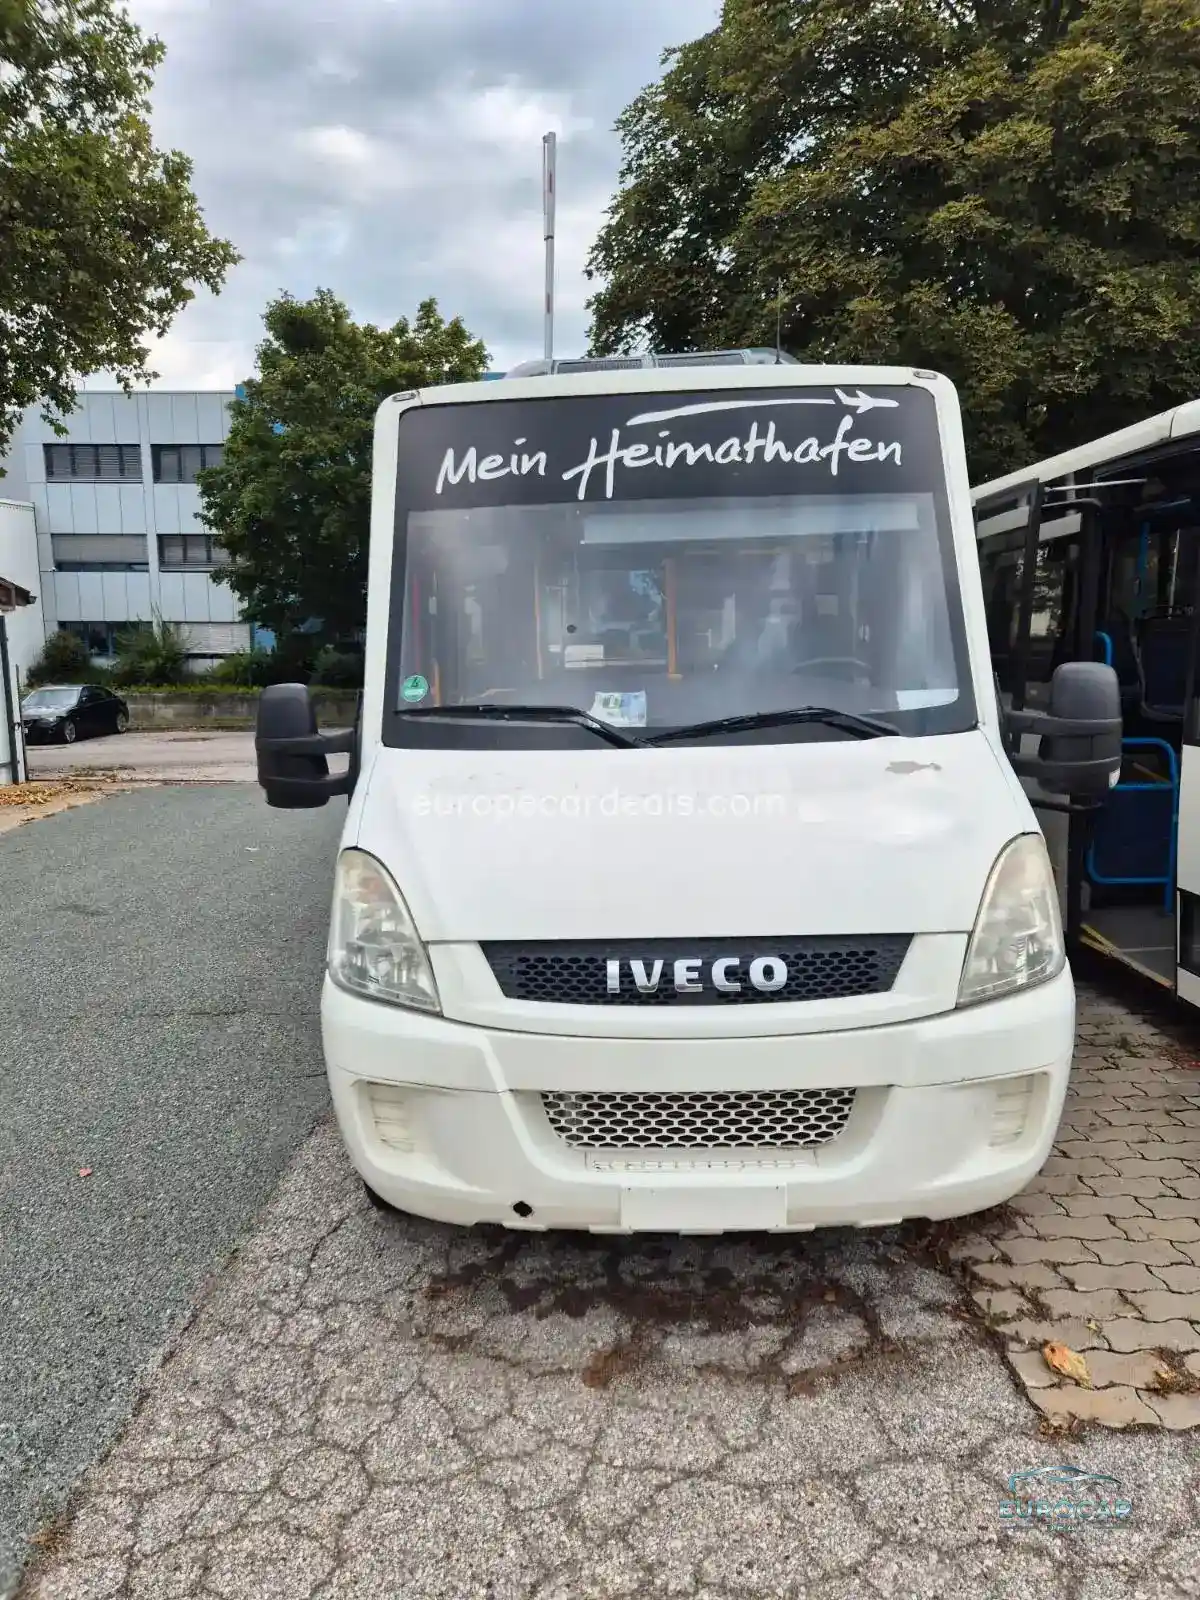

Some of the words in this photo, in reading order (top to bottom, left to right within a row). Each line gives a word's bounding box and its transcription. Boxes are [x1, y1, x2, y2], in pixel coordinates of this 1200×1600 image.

[435, 437, 547, 494] Mein
[562, 414, 902, 500] Heimathafen
[605, 956, 788, 993] IVECO
